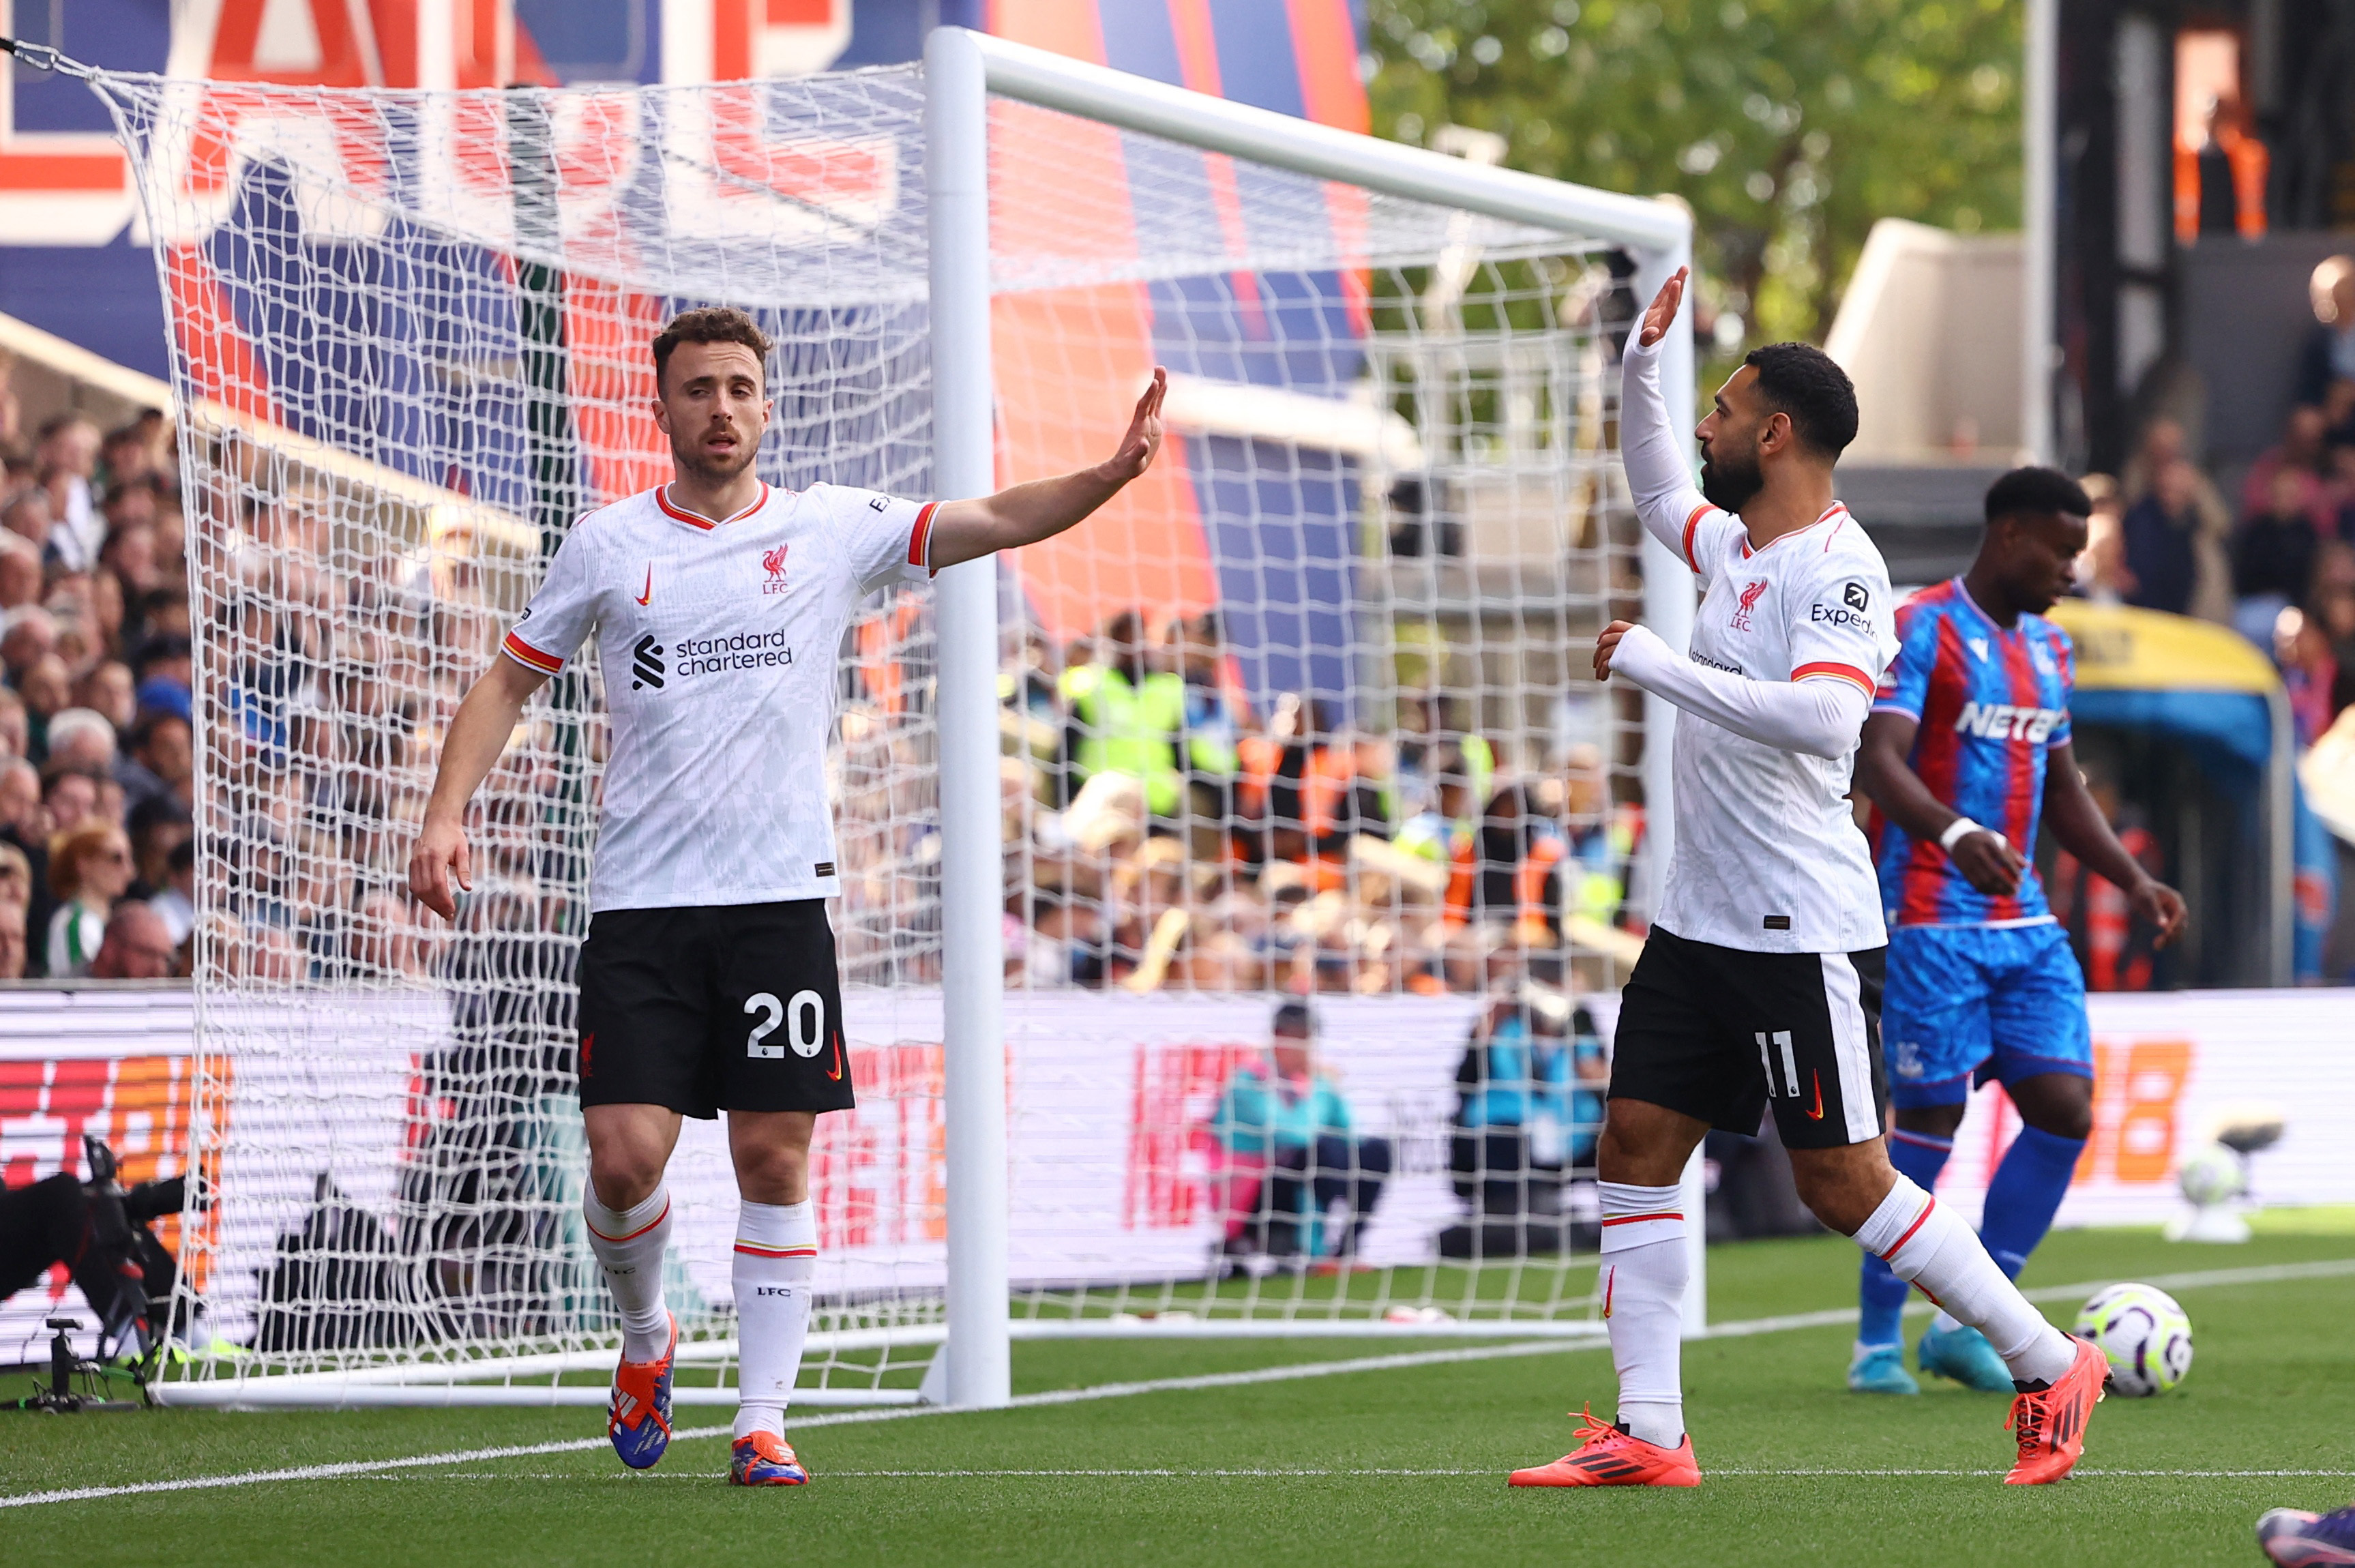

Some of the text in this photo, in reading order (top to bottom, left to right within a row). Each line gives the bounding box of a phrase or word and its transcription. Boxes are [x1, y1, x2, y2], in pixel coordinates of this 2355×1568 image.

[677, 629, 785, 658] standard
[677, 647, 793, 676] chartered
[743, 989, 825, 1059] 20
[1754, 1030, 1801, 1098] 11
[756, 1286, 791, 1297] LFC
